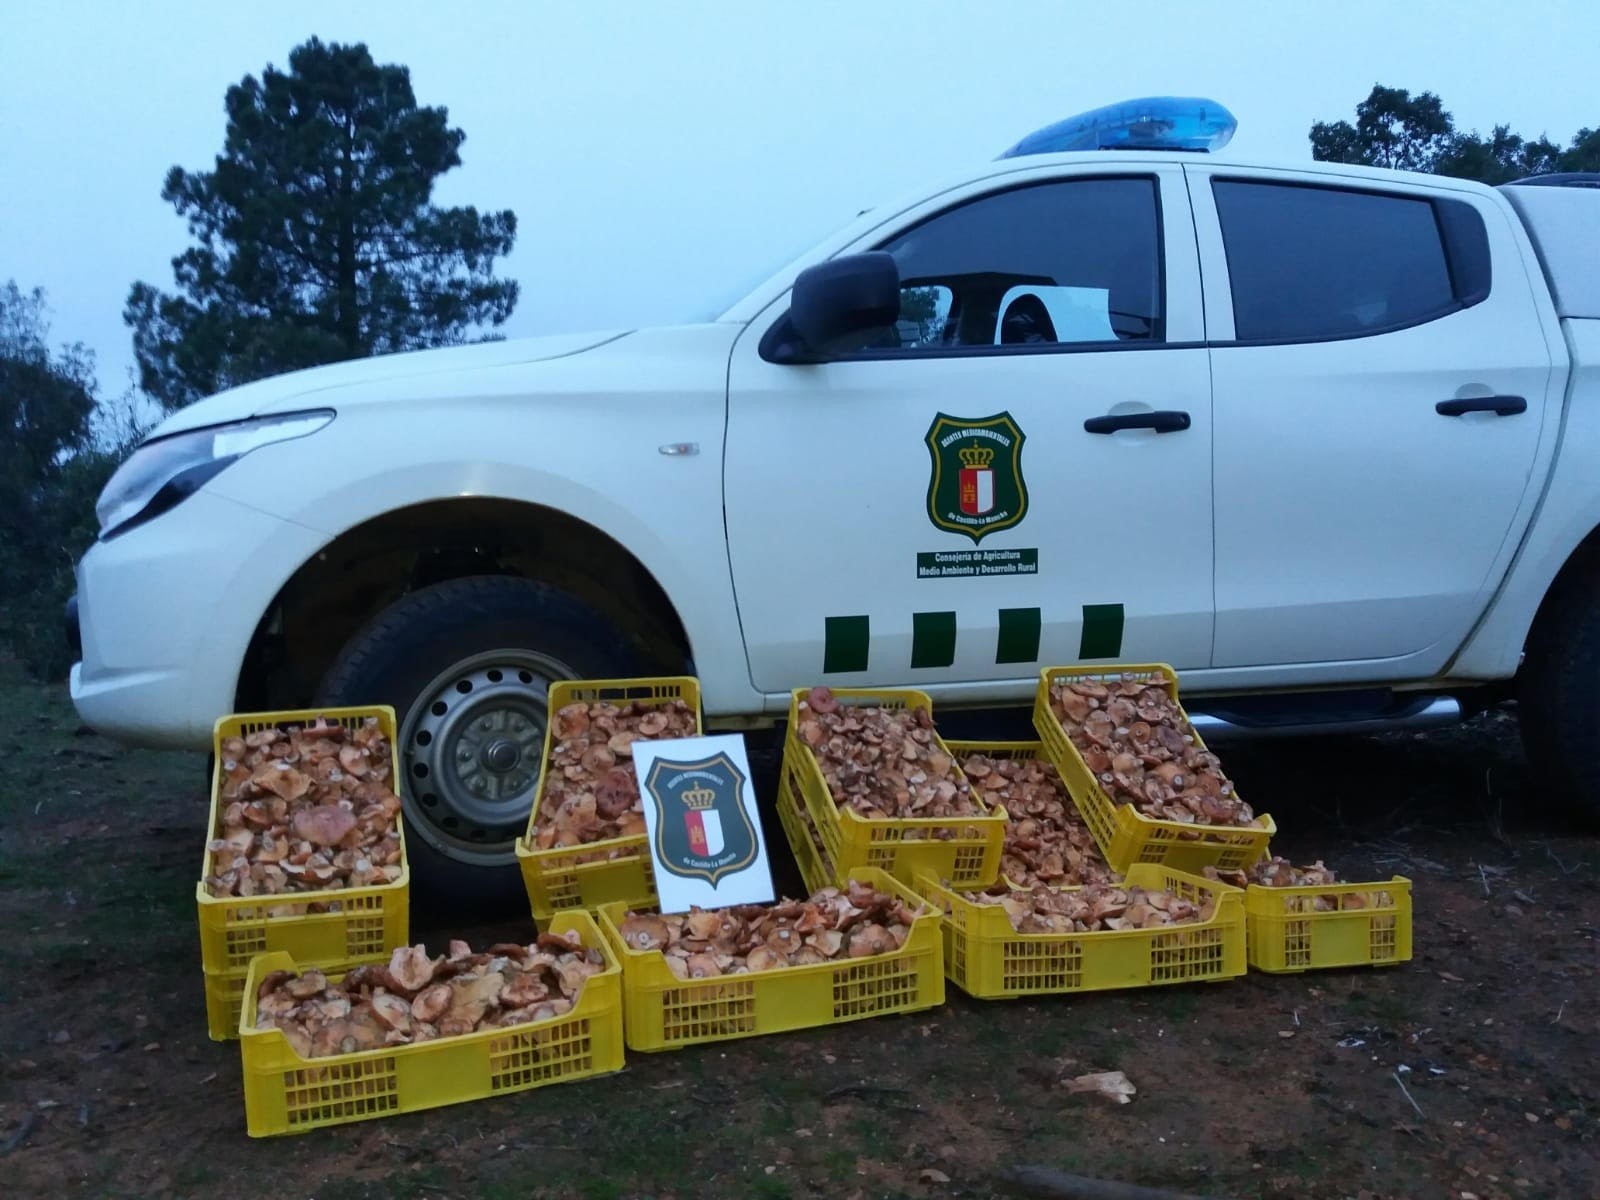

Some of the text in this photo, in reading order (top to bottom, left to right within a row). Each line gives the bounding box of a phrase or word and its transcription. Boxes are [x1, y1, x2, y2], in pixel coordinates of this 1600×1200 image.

[973, 552, 981, 560] de
[983, 550, 1020, 562] Agricultura
[920, 562, 1036, 576] Medio Ambiente y Desarrollo Rural
